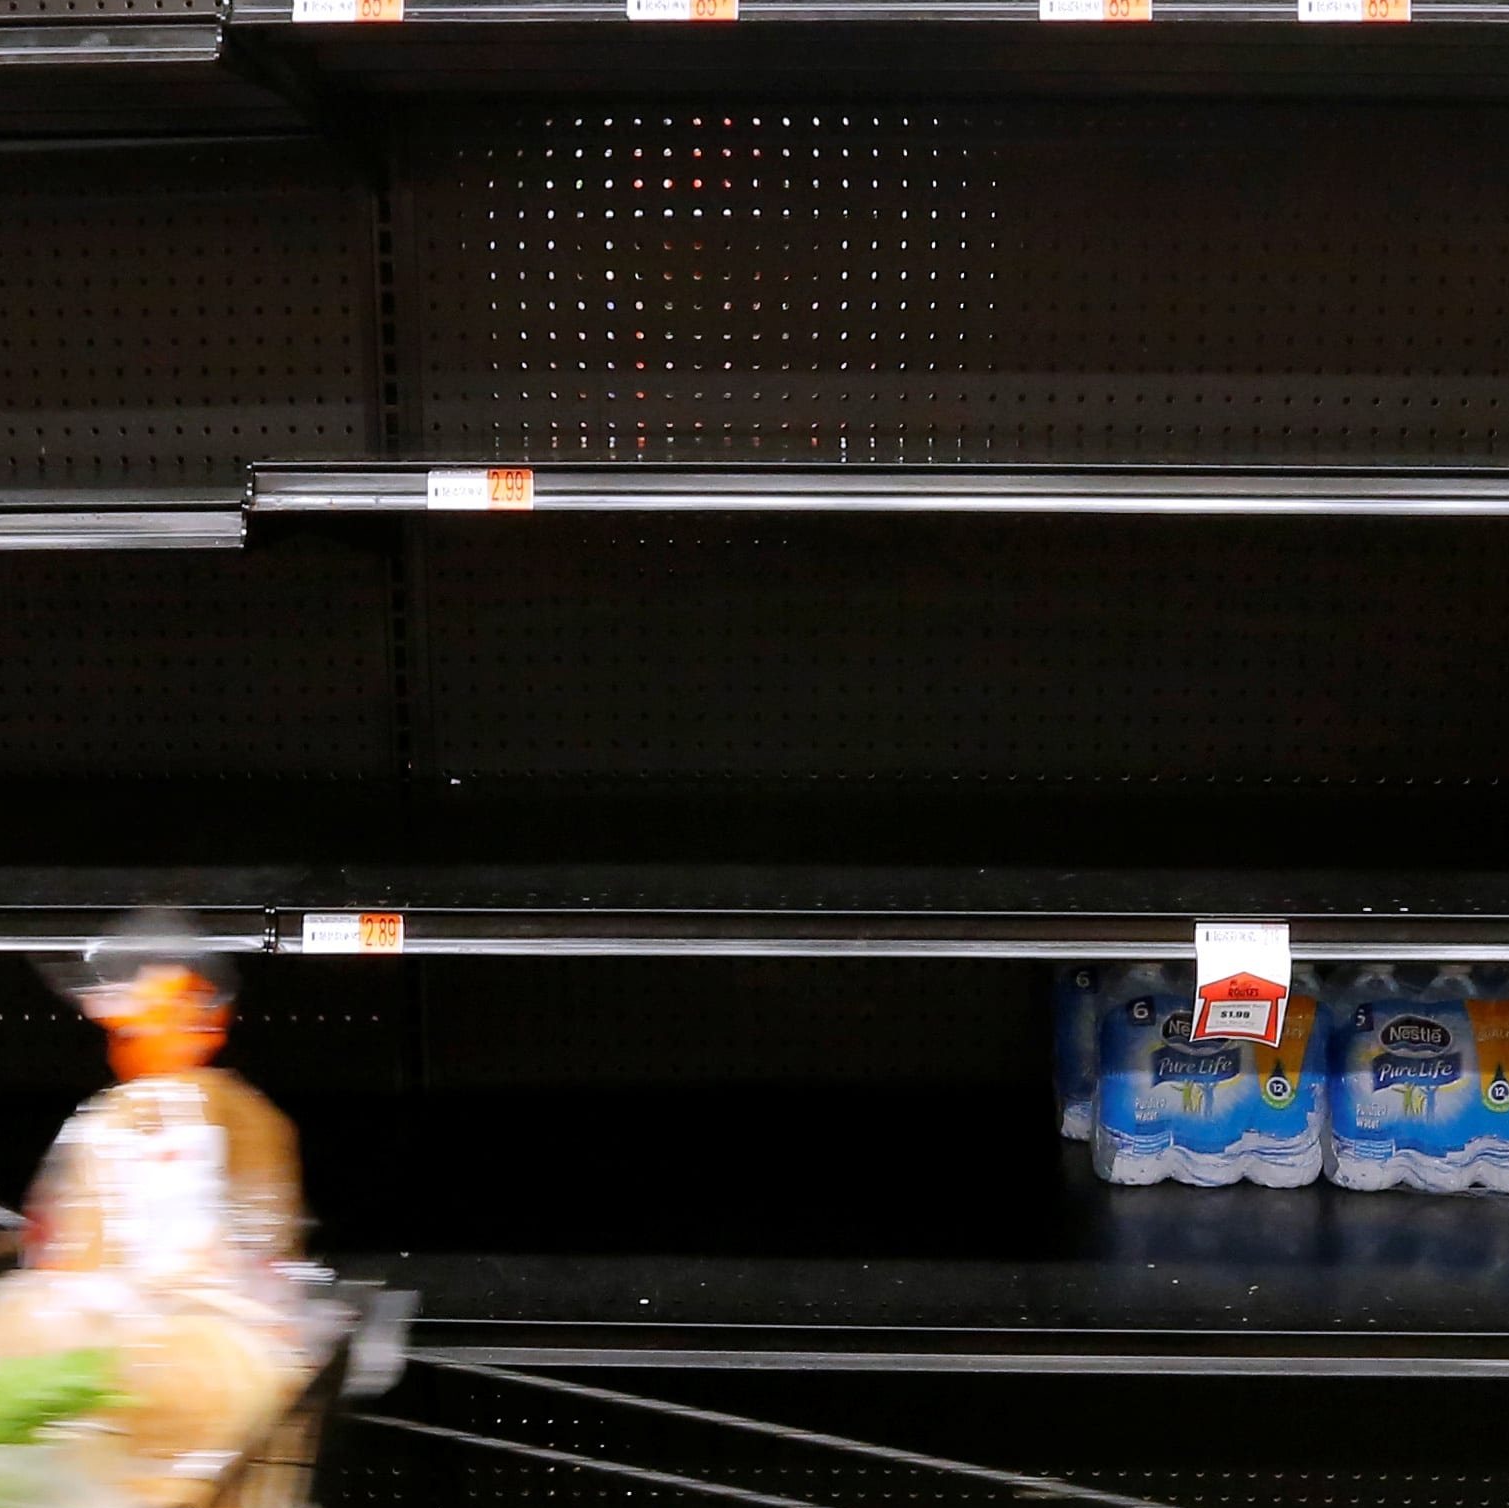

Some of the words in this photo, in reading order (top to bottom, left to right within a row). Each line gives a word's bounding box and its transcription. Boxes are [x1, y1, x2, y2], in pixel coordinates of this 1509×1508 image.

[491, 471, 524, 501] 2.99
[365, 918, 397, 946] 2.89
[1132, 1001, 1149, 1020] 6
[1159, 1056, 1193, 1076] Pure
[1199, 1055, 1233, 1075] Life
[1379, 1064, 1418, 1082] Pure
[1420, 1061, 1453, 1079] Life
[1272, 1082, 1283, 1093] 12
[1494, 1086, 1505, 1097] 12
